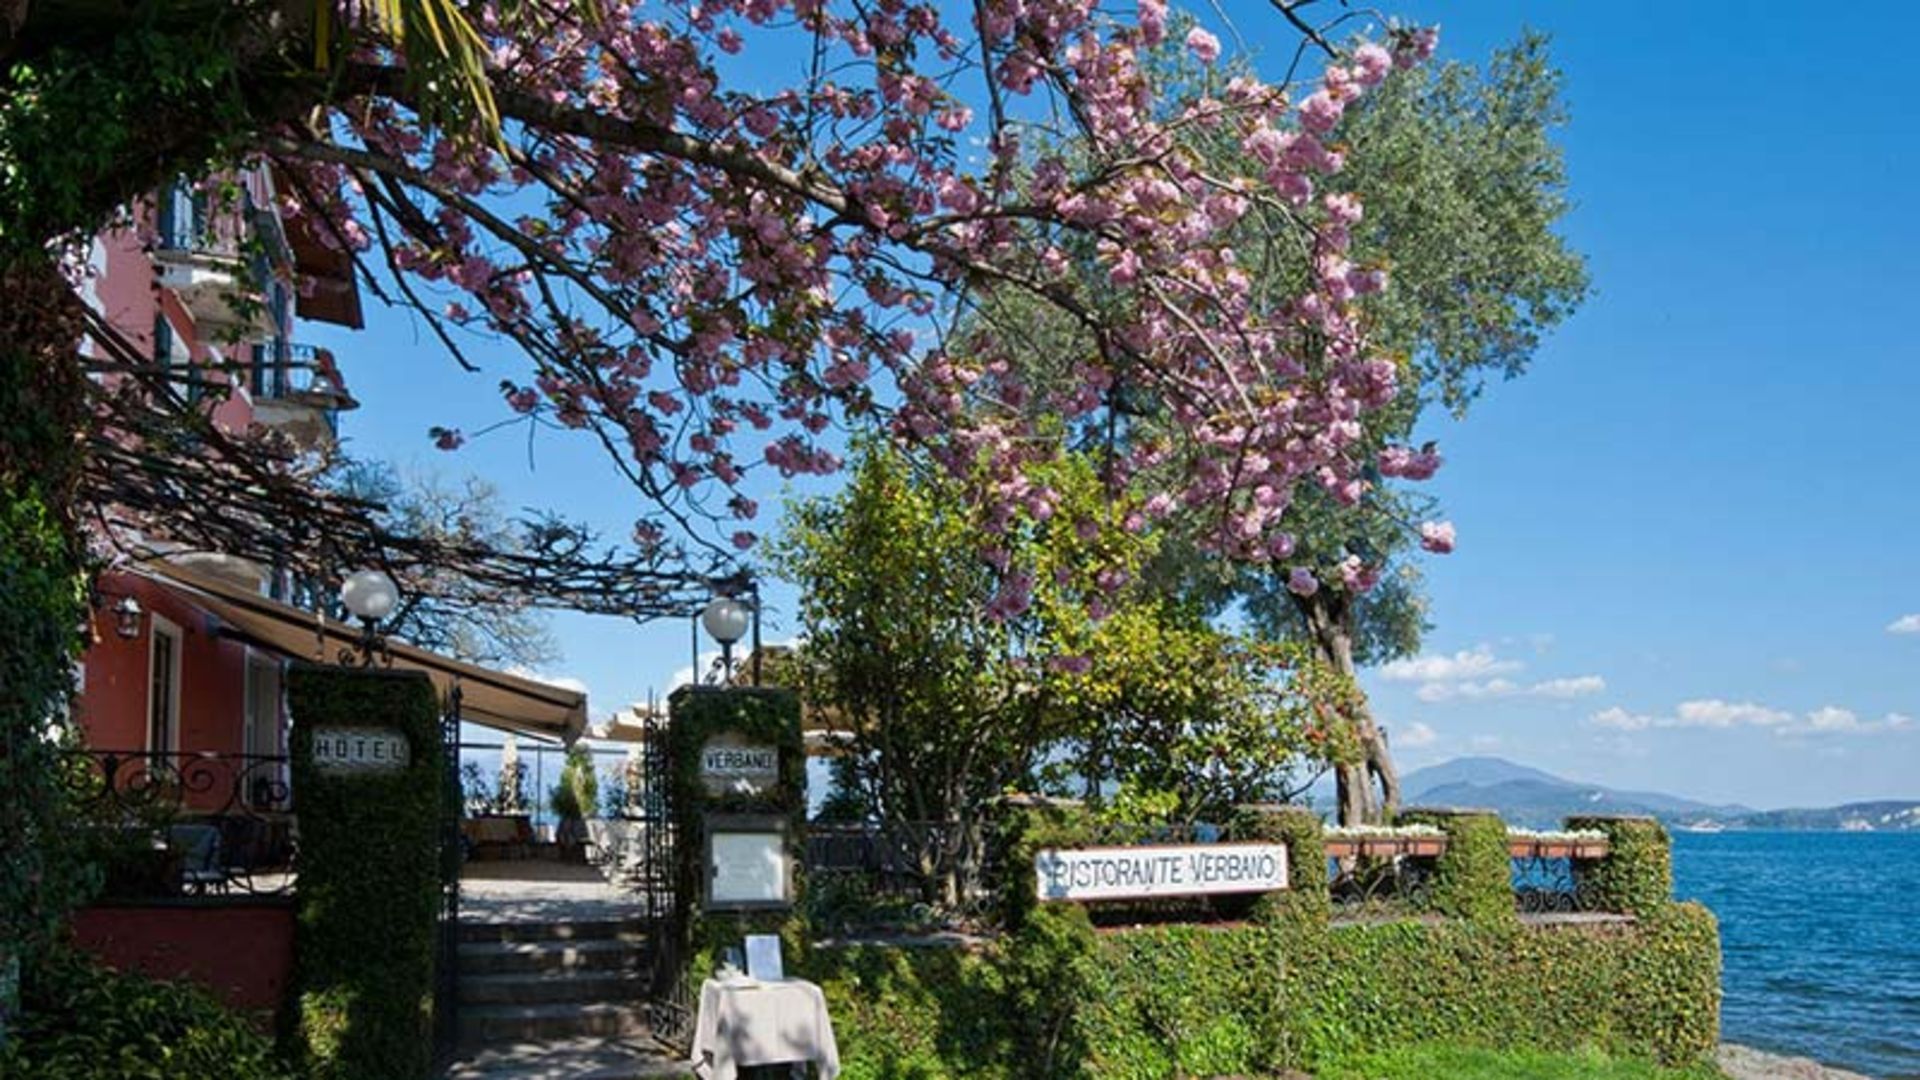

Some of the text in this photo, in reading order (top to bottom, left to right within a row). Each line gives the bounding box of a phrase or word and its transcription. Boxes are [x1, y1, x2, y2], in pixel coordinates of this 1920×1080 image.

[315, 739, 404, 760] HOTEL
[706, 751, 772, 769] VERBANO
[1050, 852, 1276, 888] RISTORANTE VERBANO
